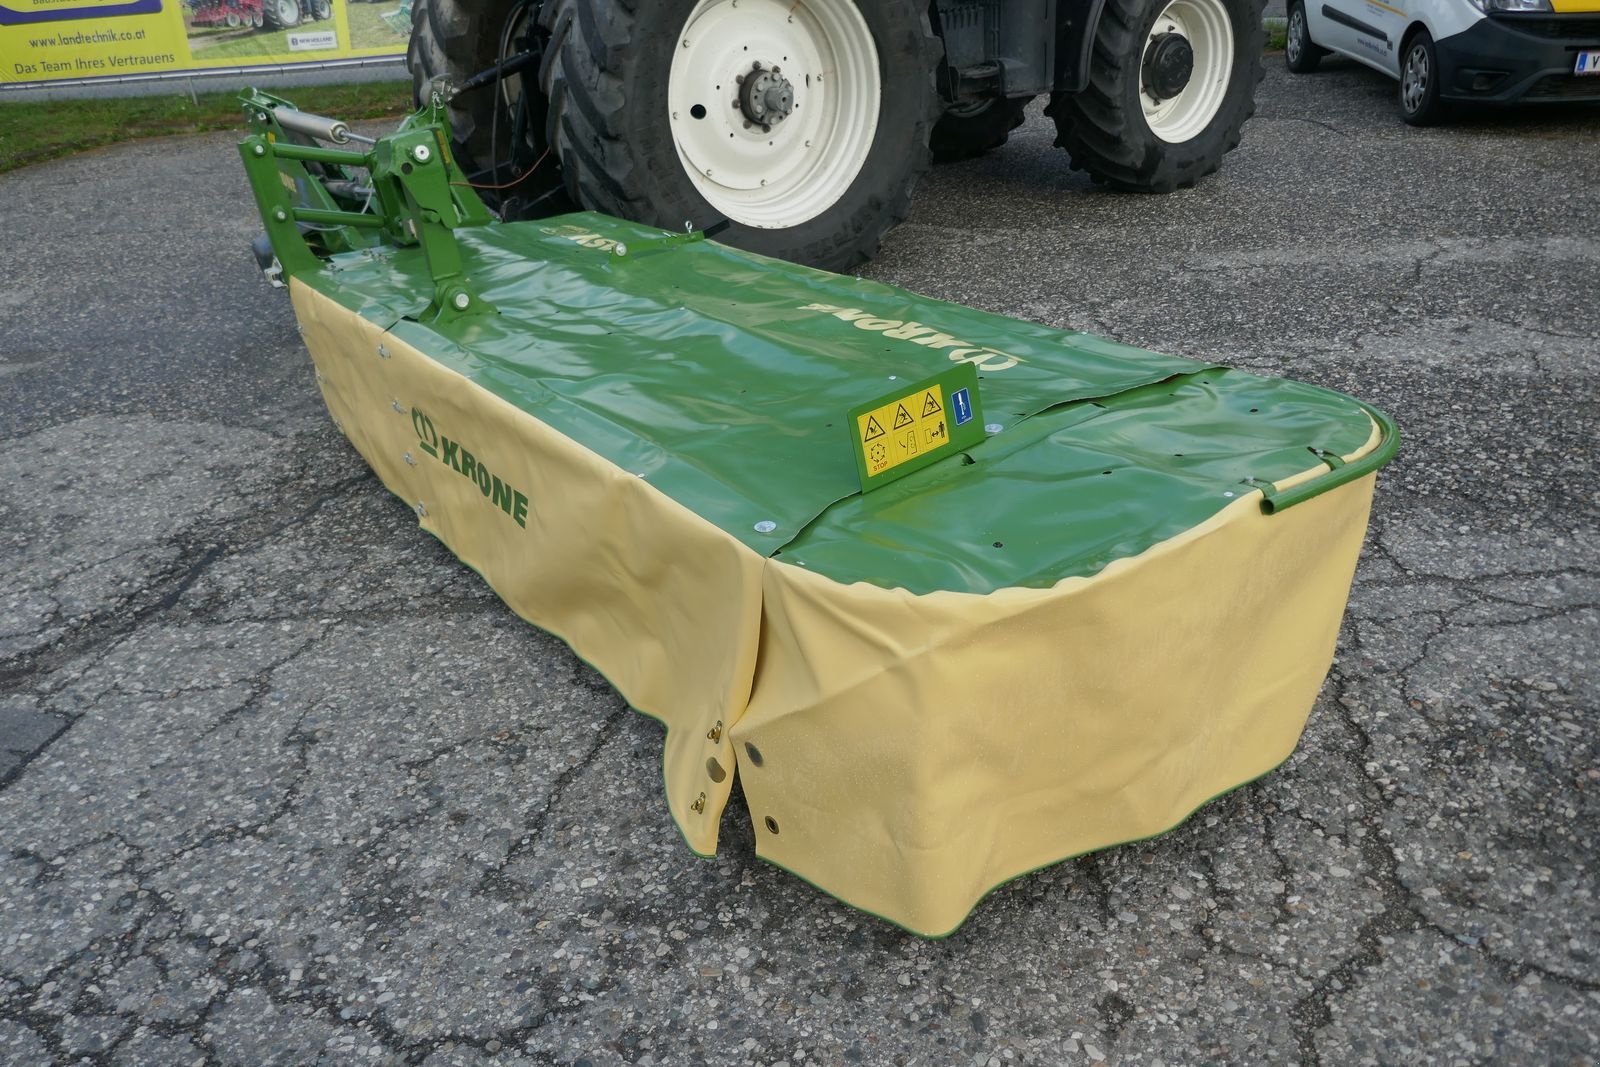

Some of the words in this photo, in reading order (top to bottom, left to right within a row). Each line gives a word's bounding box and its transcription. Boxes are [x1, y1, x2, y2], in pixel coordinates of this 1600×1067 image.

[29, 29, 146, 48] www.landtechnik.co.at
[14, 63, 37, 75] Das
[40, 60, 72, 73] Team
[75, 57, 105, 70] Ihres
[108, 53, 175, 67] Vertrauens
[873, 460, 889, 472] STOP
[441, 435, 529, 529] KRONE
